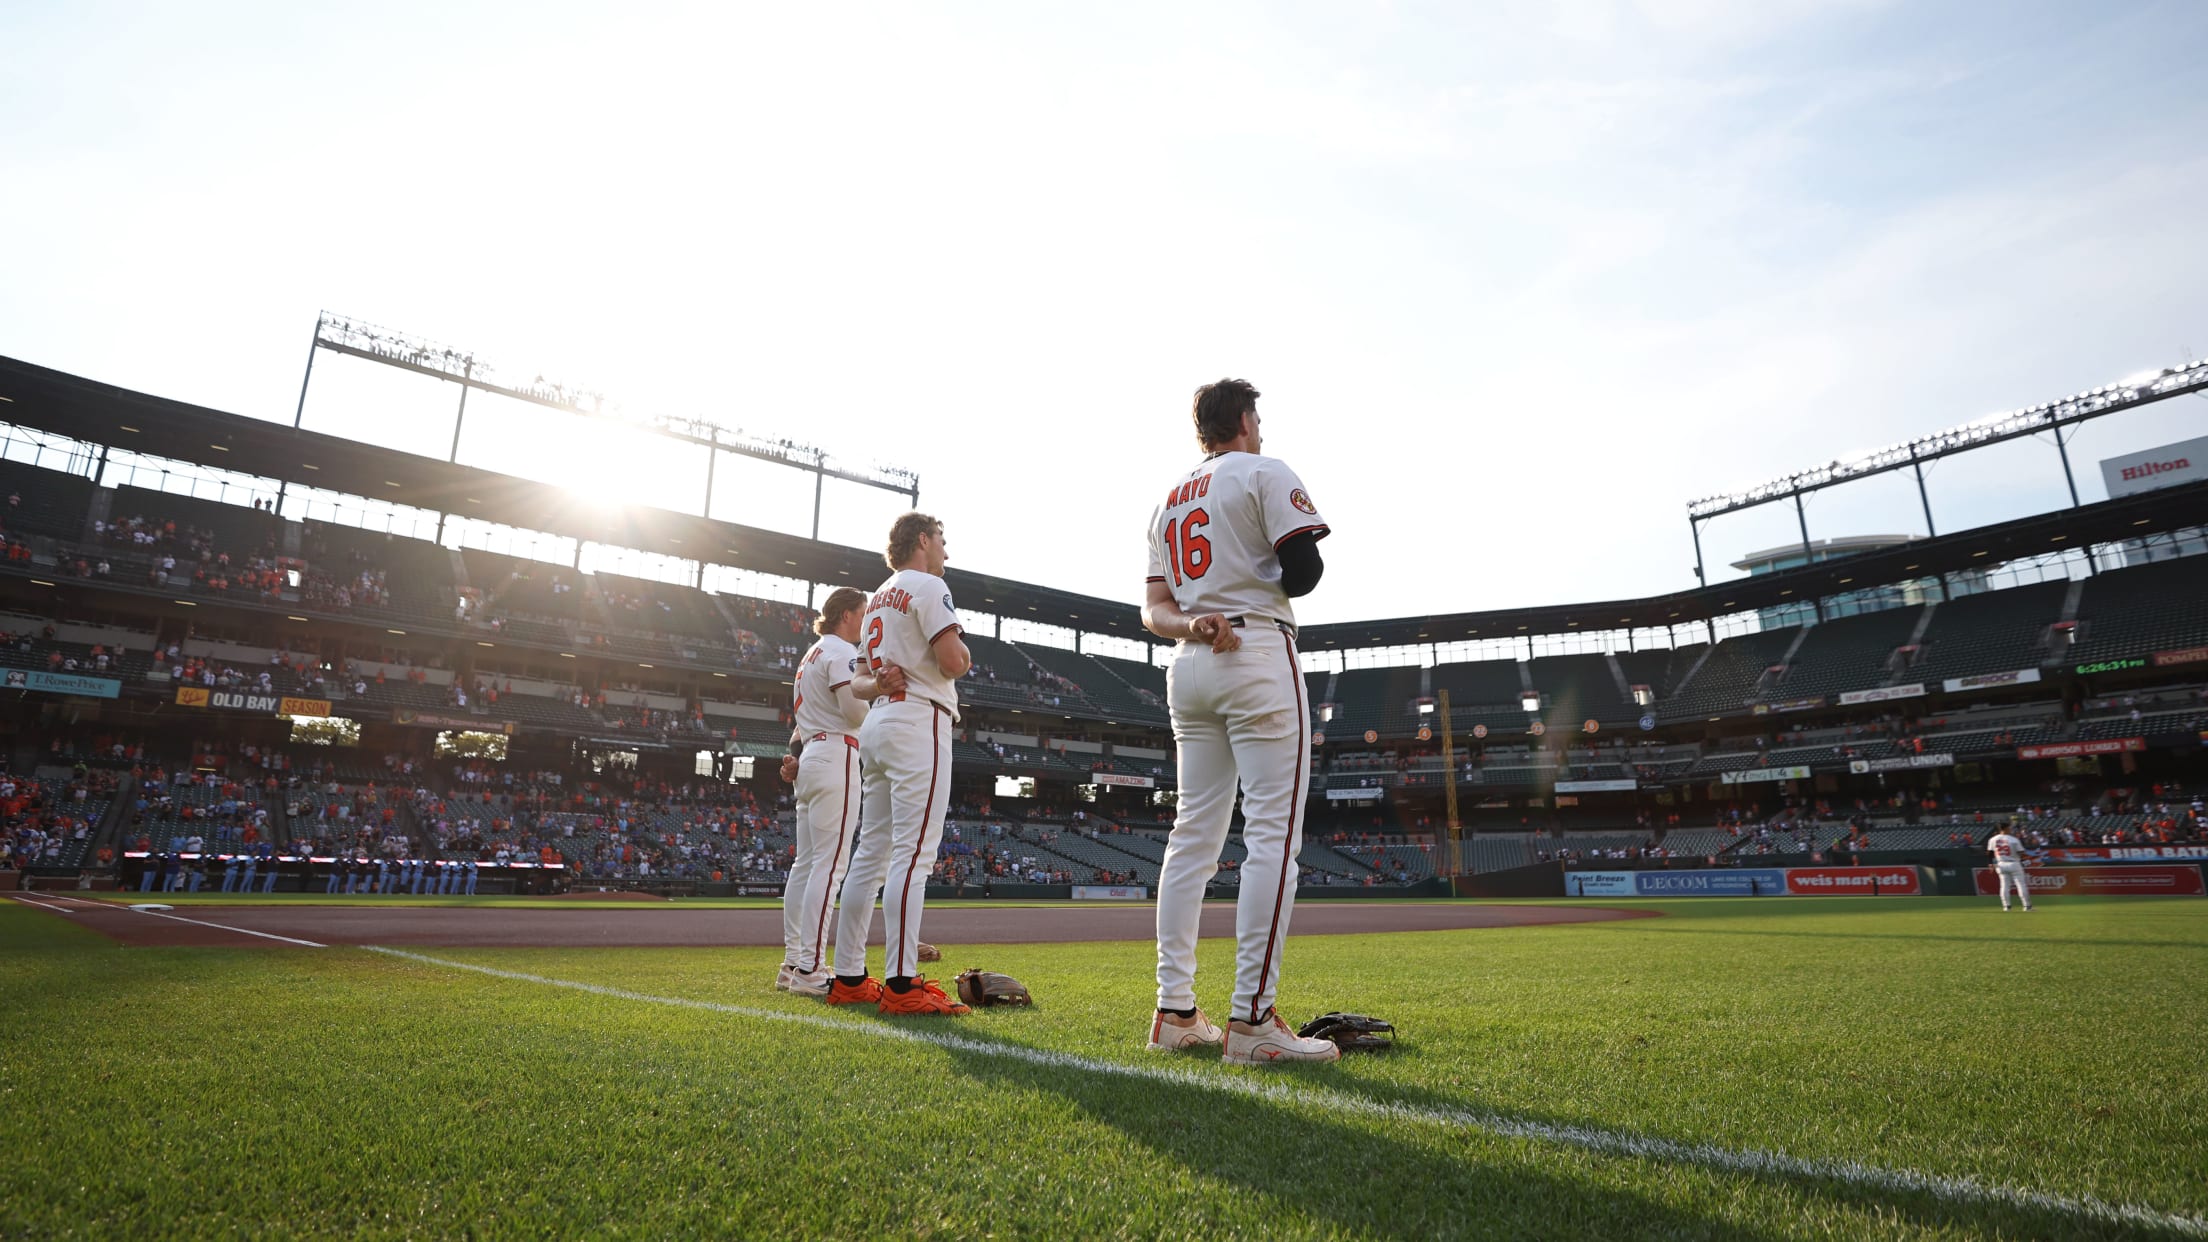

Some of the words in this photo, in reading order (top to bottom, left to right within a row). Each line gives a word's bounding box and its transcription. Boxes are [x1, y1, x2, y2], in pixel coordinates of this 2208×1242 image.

[2121, 458, 2190, 481] Hilton
[1166, 472, 1213, 510] MAYO
[1164, 507, 1213, 587] 16
[865, 587, 913, 614] DERSON
[868, 616, 883, 670] 2
[76, 679, 104, 690] Price
[213, 692, 243, 708] OLD
[246, 695, 277, 711] BAY
[284, 698, 327, 715] SEASON
[1910, 754, 1954, 766] UNION
[2110, 848, 2157, 859] BIRD
[1596, 874, 1625, 882] Breeze
[1642, 876, 1708, 889] LECOM
[1795, 874, 1833, 886] weis
